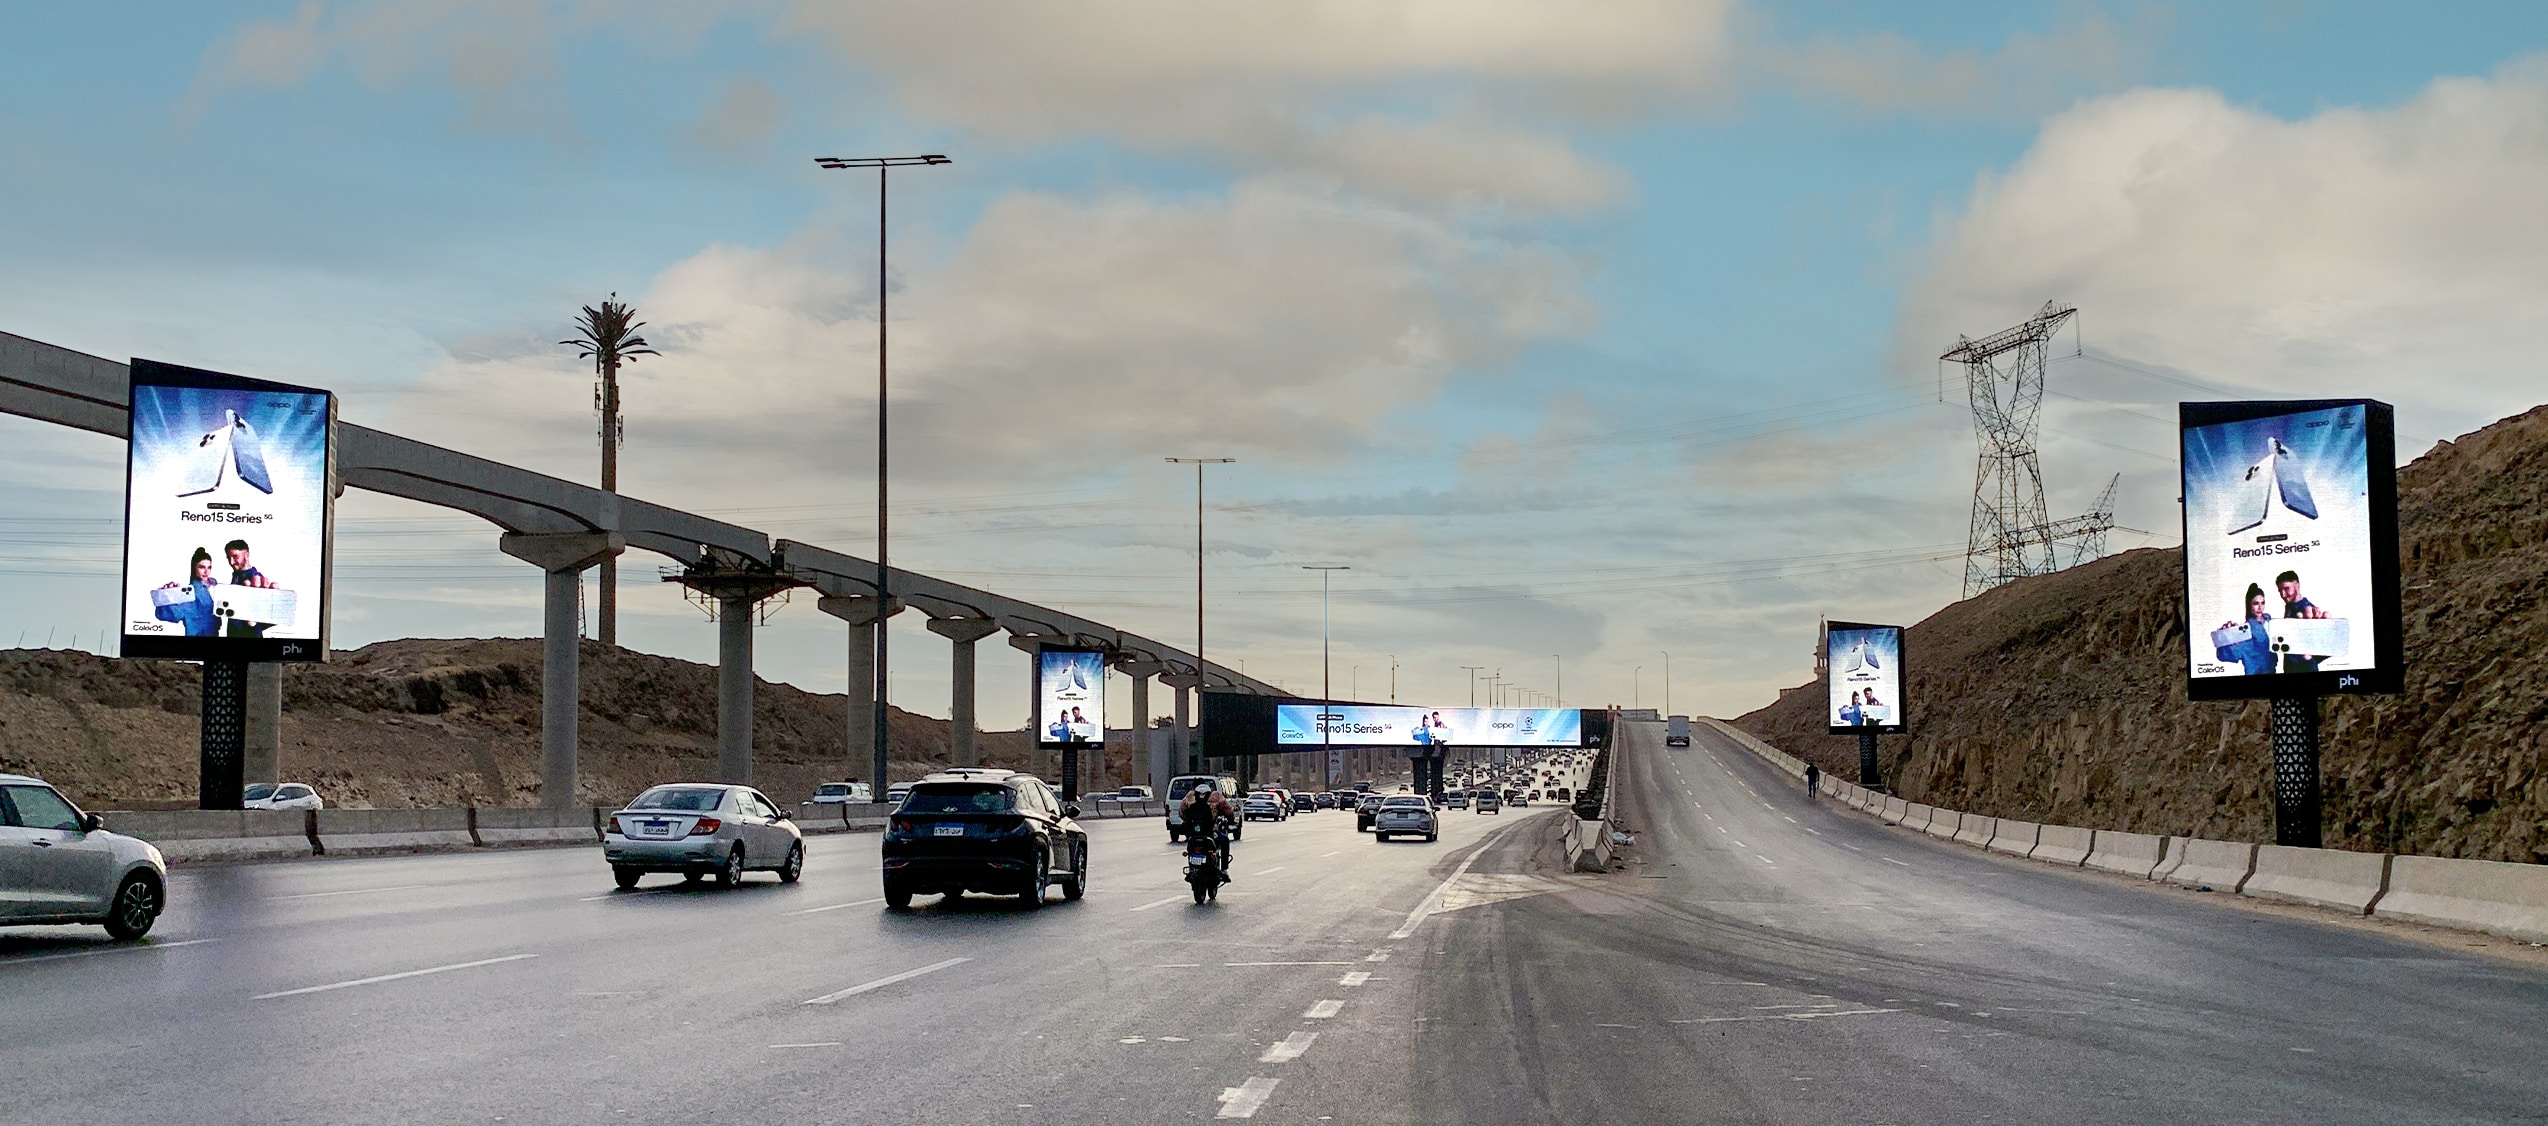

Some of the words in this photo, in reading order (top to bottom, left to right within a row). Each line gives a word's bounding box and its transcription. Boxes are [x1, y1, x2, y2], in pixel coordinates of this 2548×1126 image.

[181, 510, 224, 523] Reno15
[226, 512, 262, 524] Series
[2233, 545, 2273, 558] Reno15
[2275, 542, 2310, 555] Series
[133, 624, 163, 632] ColorOS
[2197, 665, 2225, 674] ColorOS
[1353, 723, 1383, 734] Series
